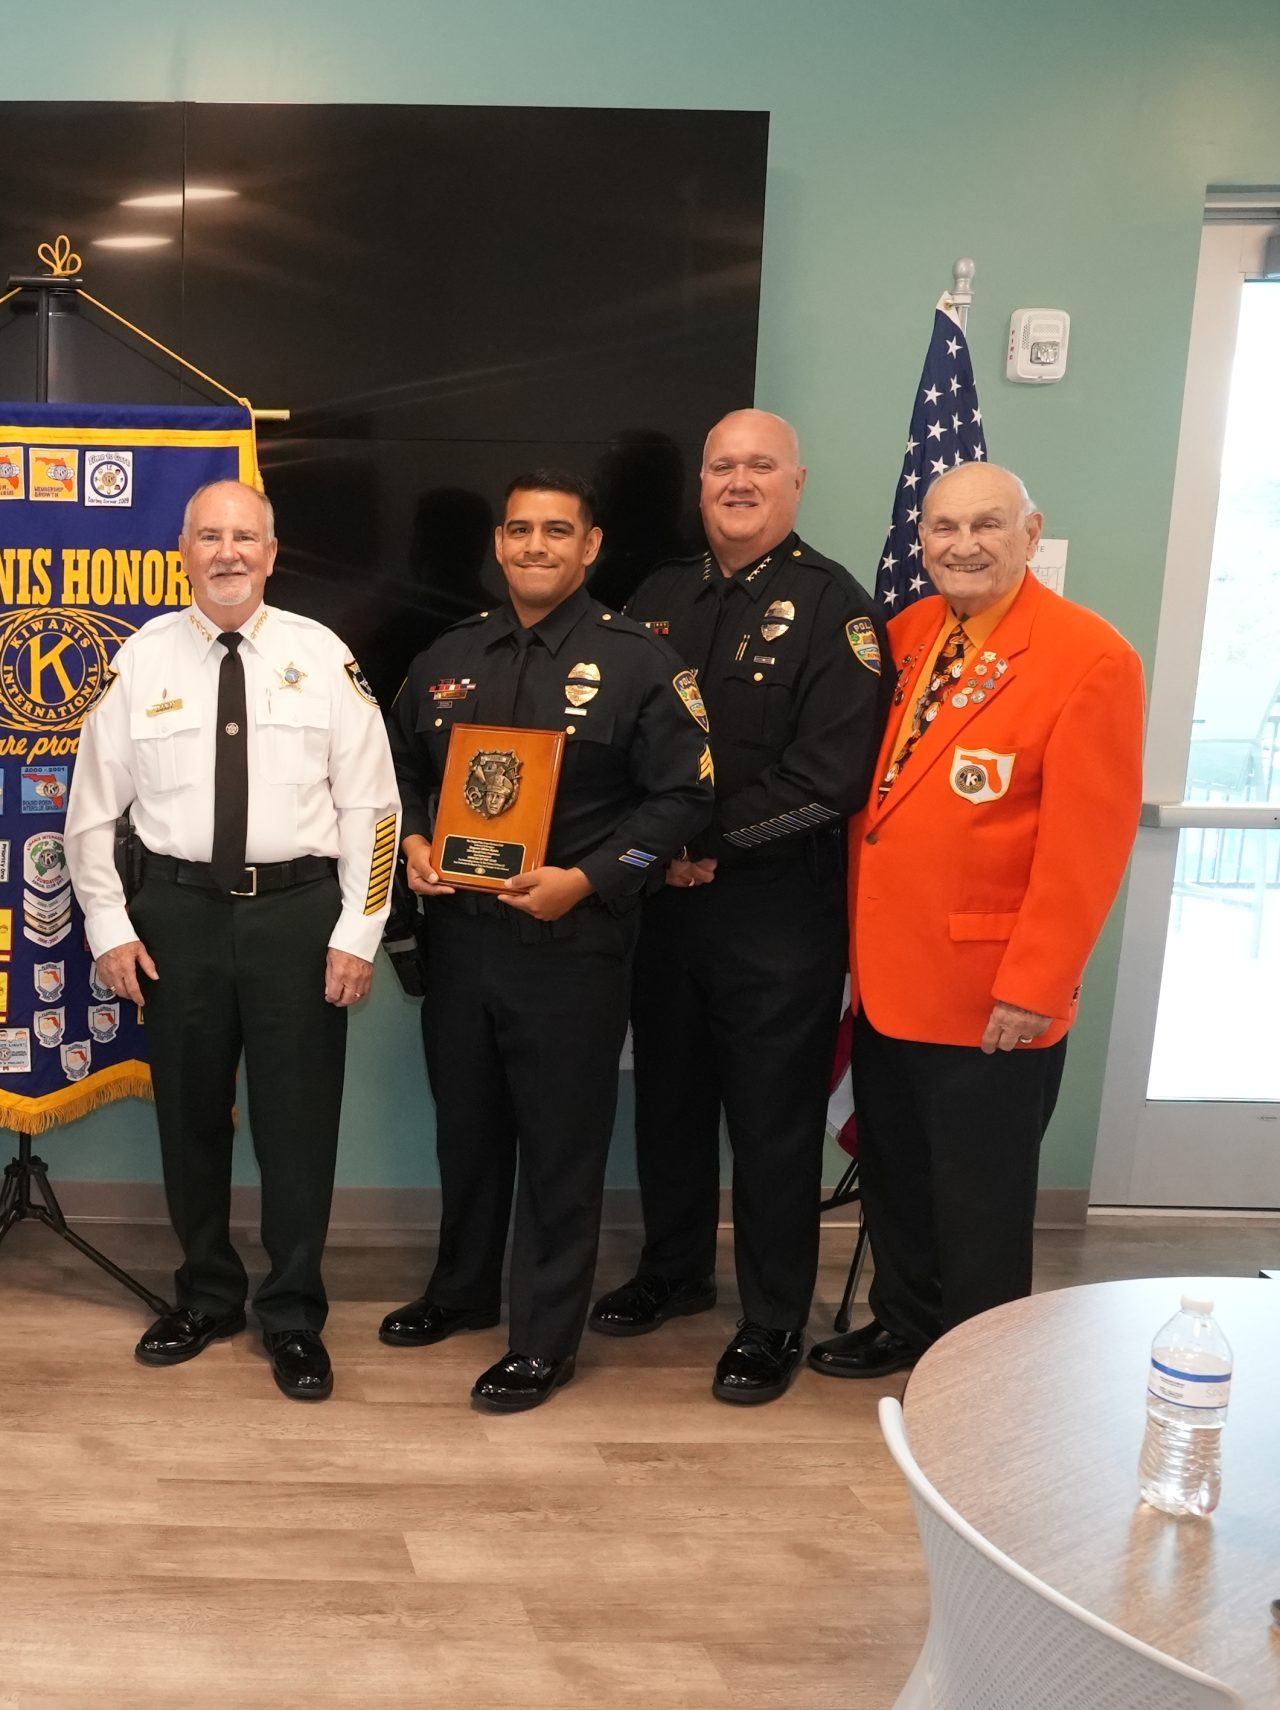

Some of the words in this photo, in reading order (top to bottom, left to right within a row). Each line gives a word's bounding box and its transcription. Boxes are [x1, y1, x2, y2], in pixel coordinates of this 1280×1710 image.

[61, 549, 194, 607] HONOR
[11, 618, 91, 650] KIWANIS
[2, 663, 99, 719] INTERNATIONAL
[24, 635, 79, 706] K
